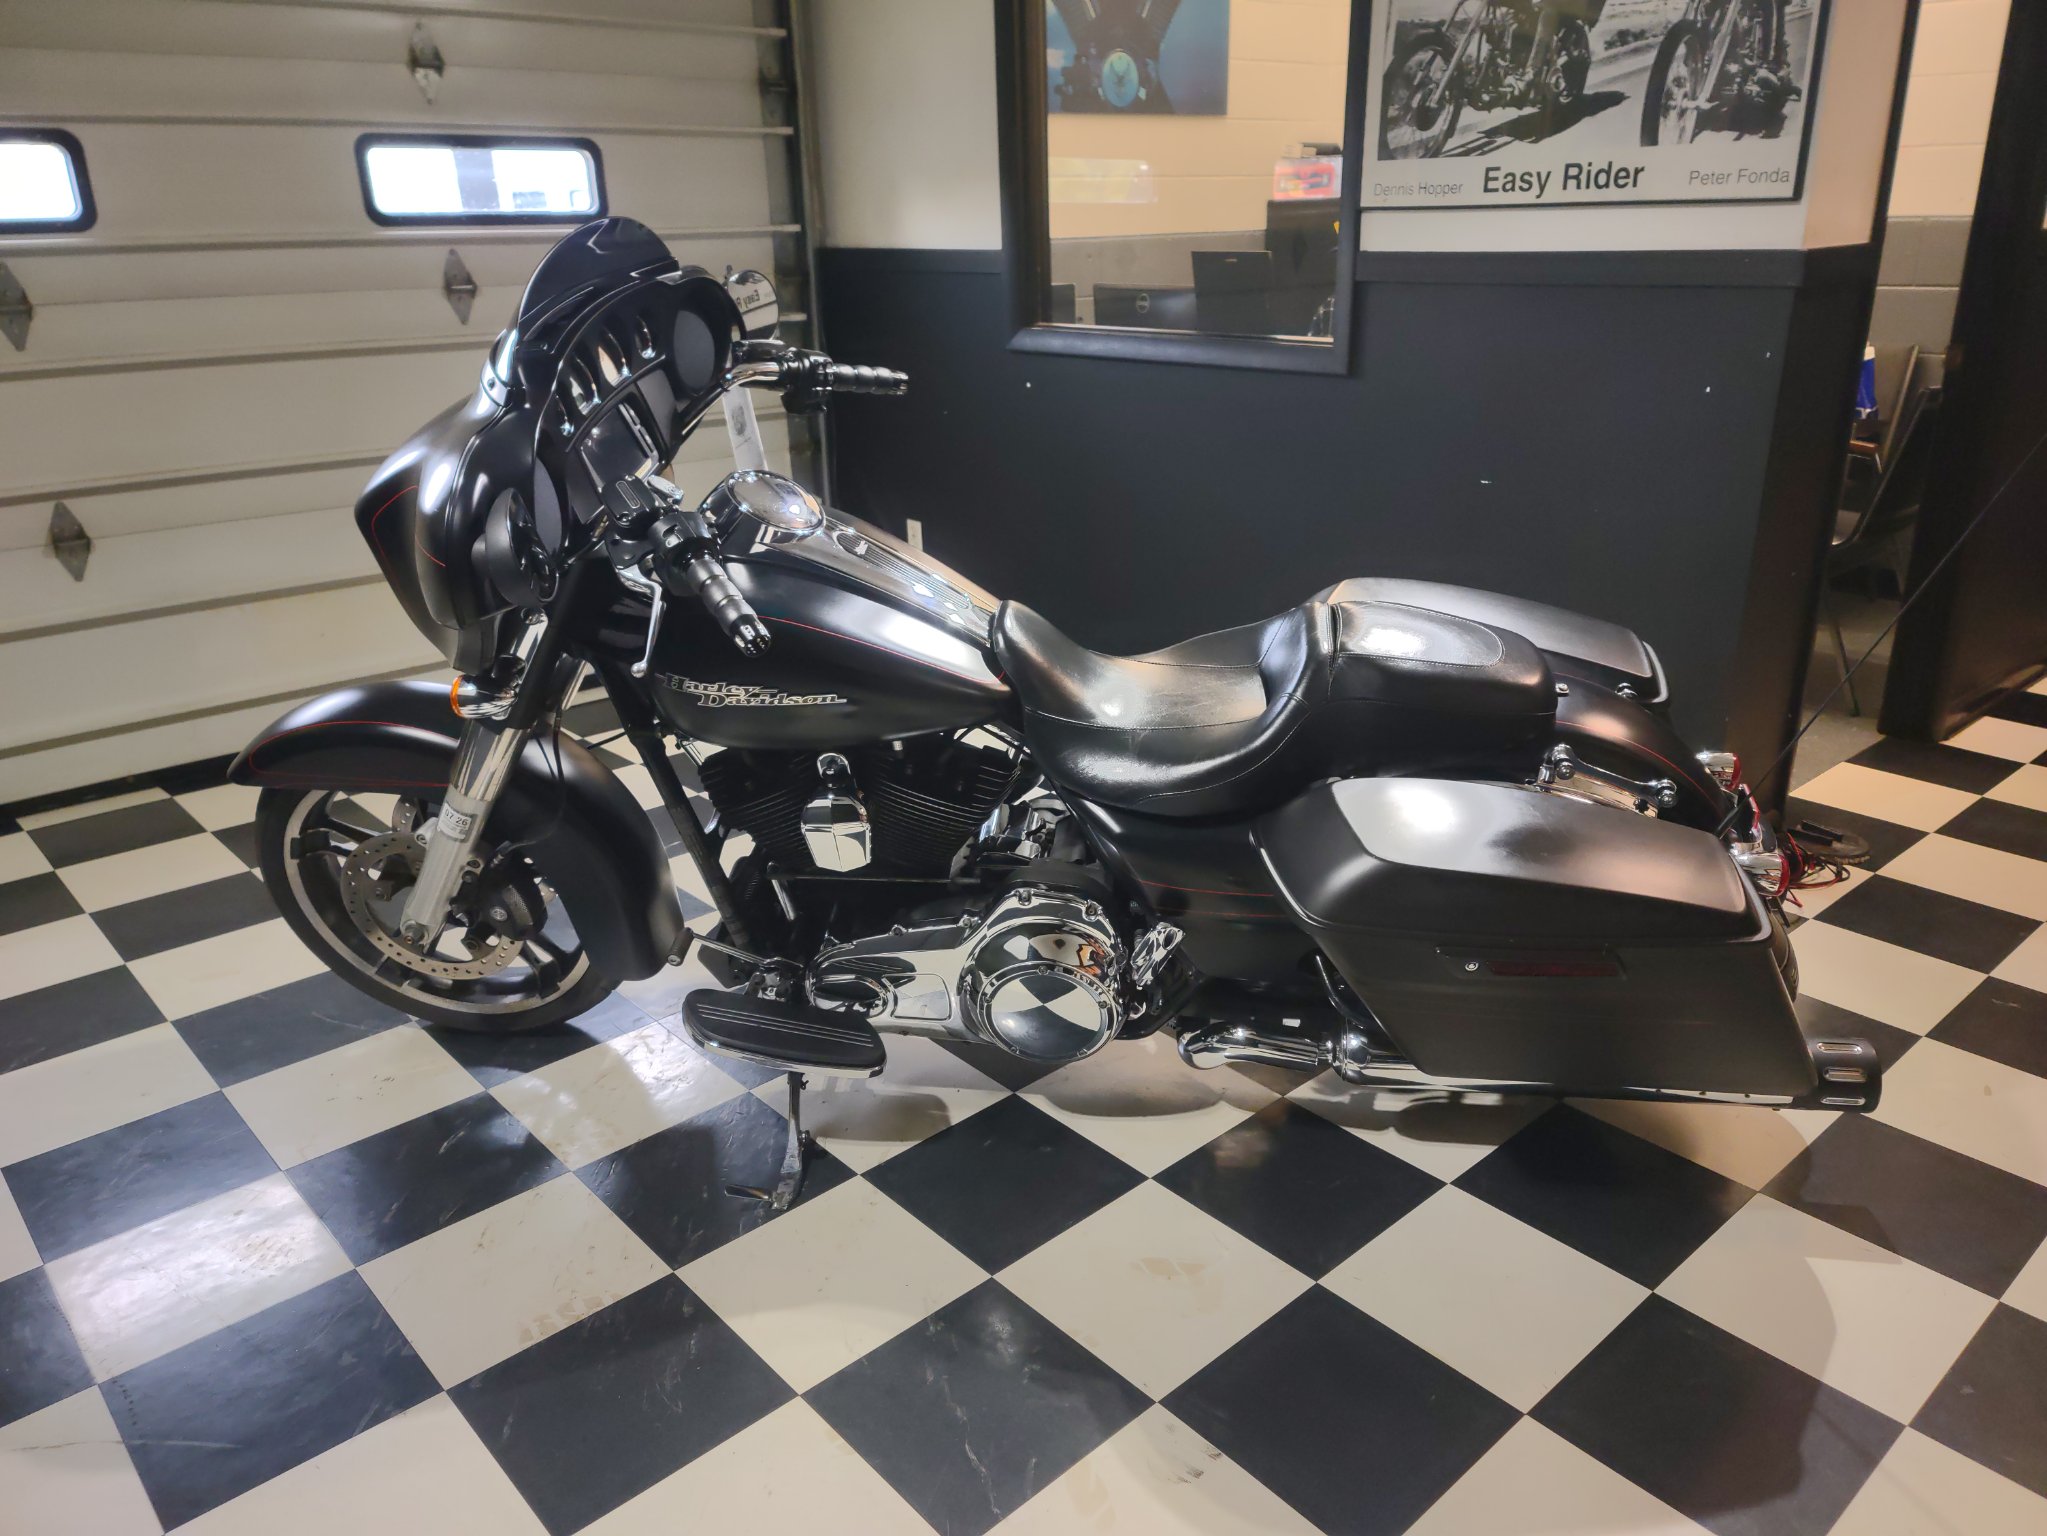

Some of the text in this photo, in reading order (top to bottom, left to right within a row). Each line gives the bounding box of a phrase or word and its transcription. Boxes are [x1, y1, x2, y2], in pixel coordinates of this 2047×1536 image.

[1483, 161, 1645, 199] Easy Rider
[1688, 168, 1790, 186] Peter Fonda
[1373, 181, 1464, 199] Dennis Hopper
[697, 692, 848, 708] Davidson
